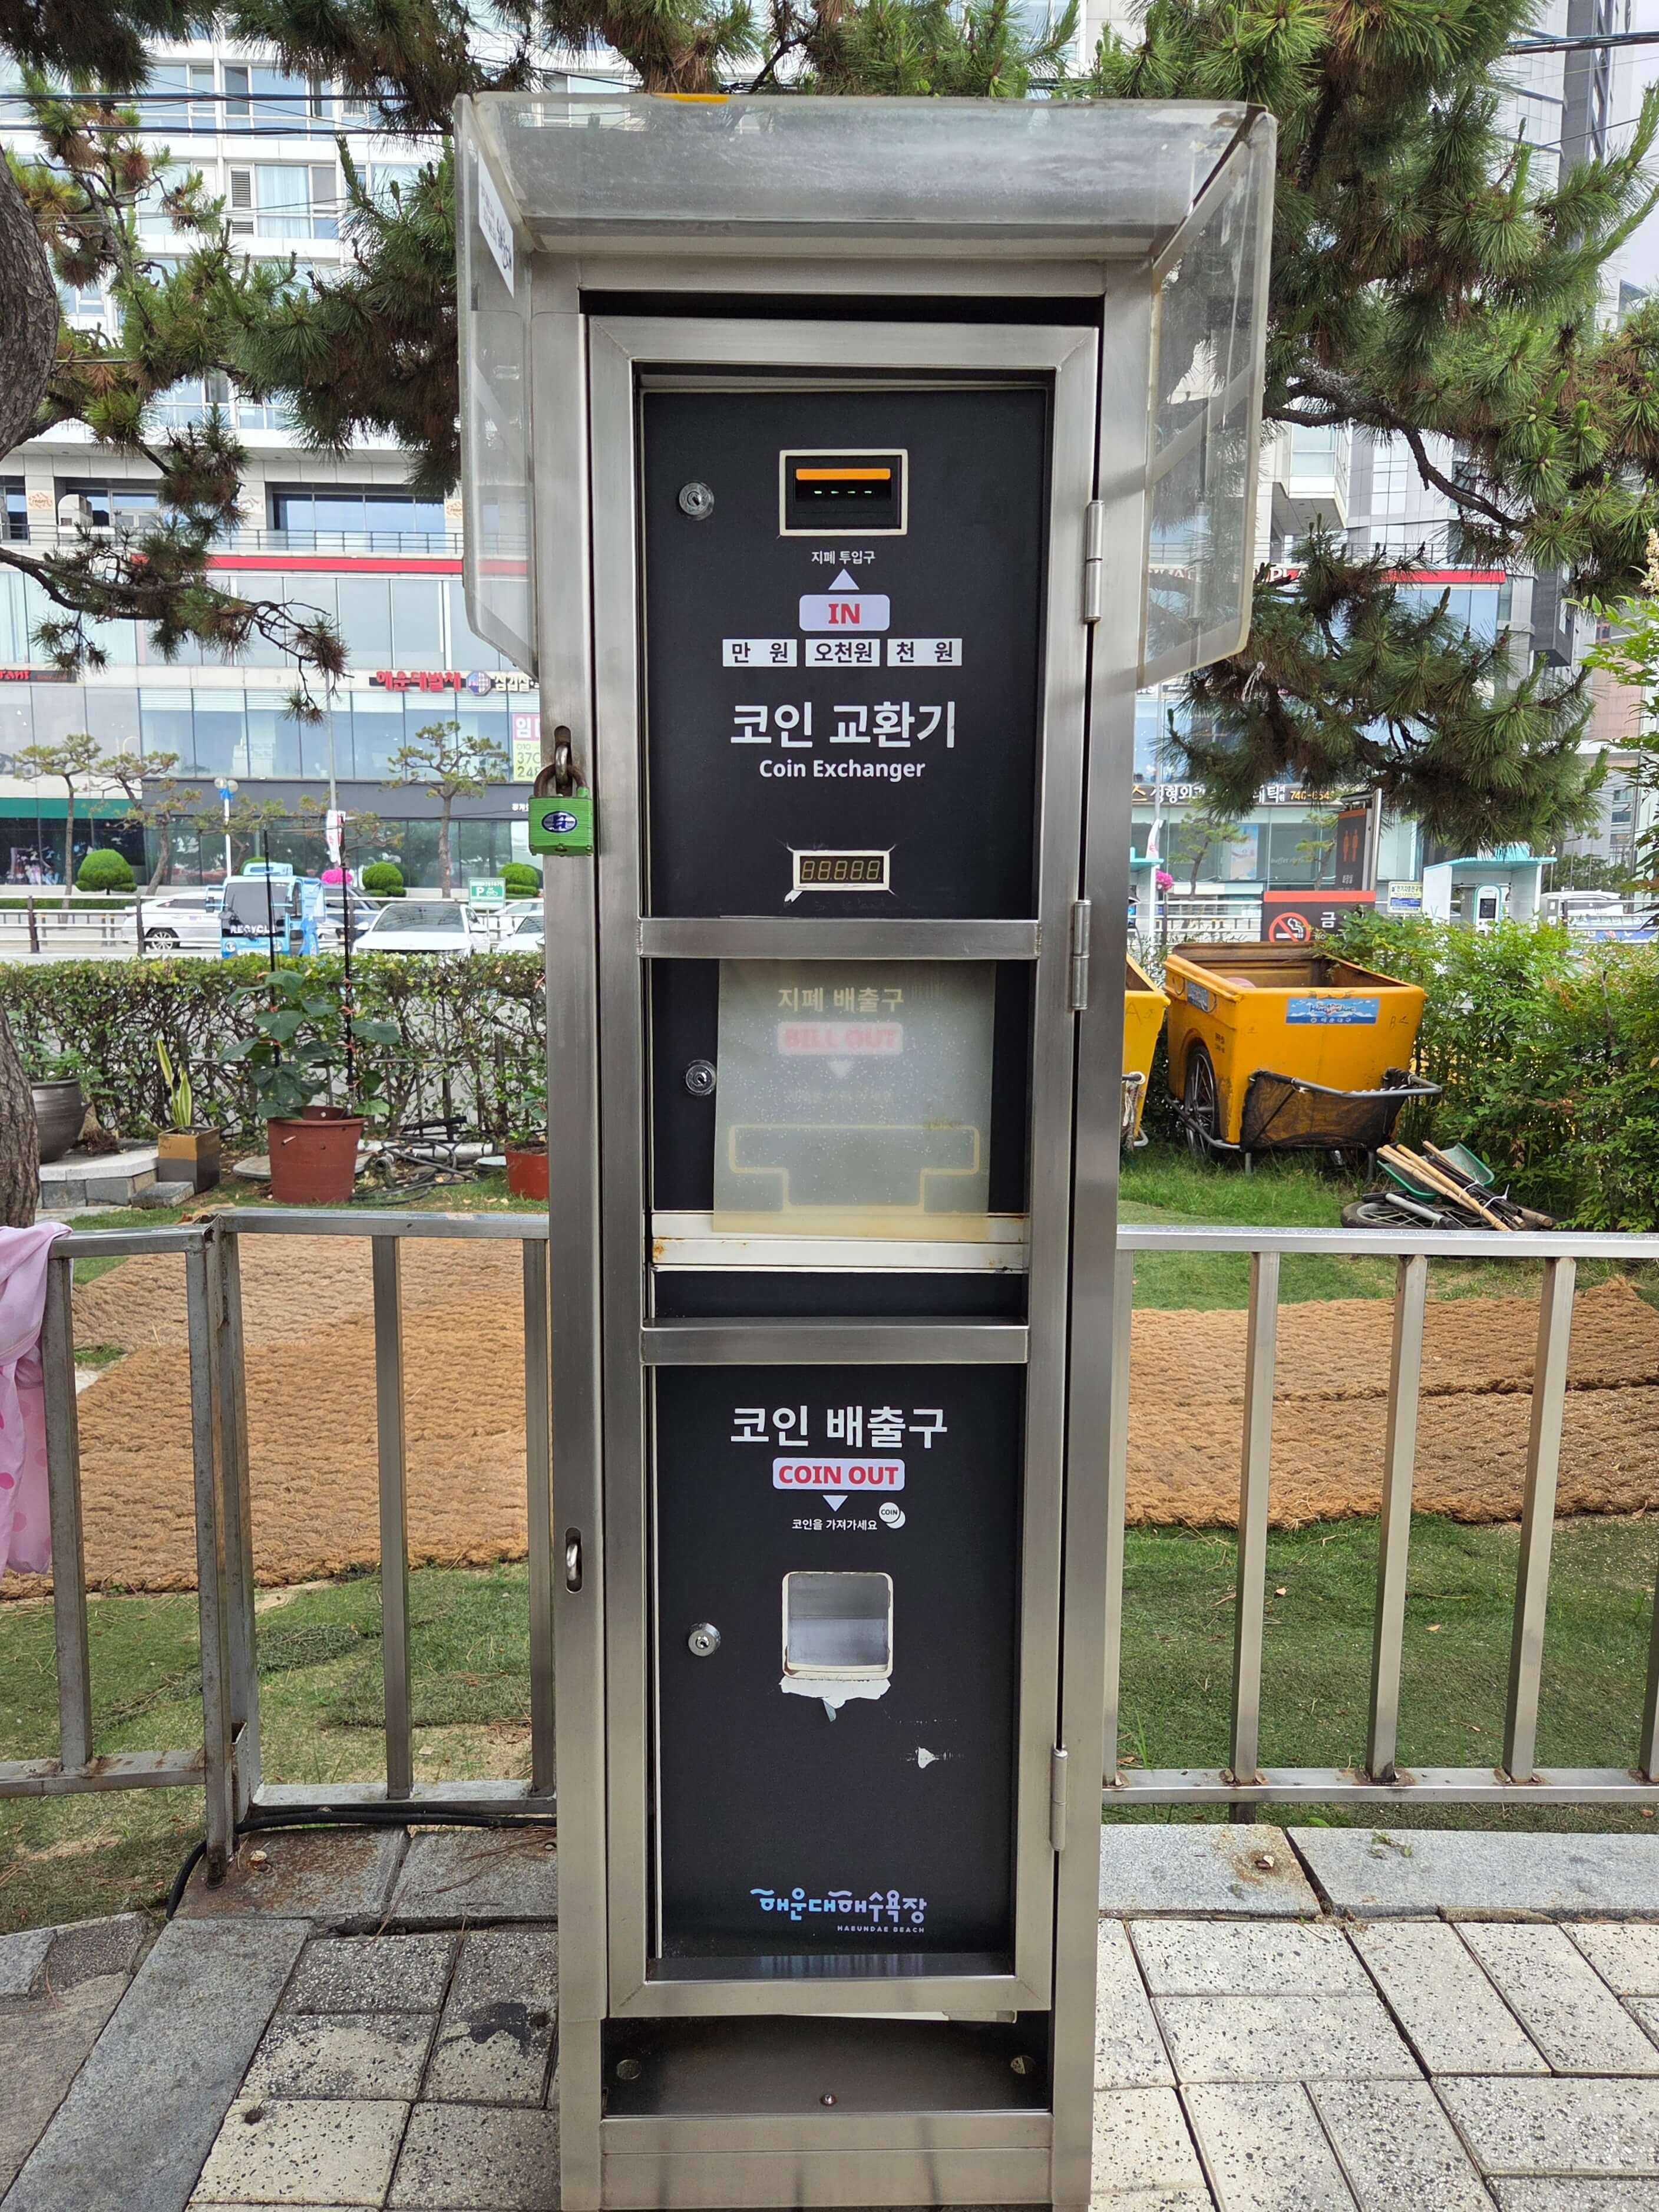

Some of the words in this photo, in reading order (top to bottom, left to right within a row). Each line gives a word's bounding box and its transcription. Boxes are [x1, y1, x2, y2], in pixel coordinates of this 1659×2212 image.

[811, 550, 835, 564] 지폐
[839, 550, 876, 564] 투입구
[828, 603, 860, 624] IN
[732, 642, 751, 663] 만
[769, 642, 788, 663] 원
[814, 641, 873, 663] 오천원
[896, 641, 914, 663] 천
[934, 641, 953, 663] 원
[730, 702, 813, 748] 코인
[830, 701, 956, 748] 교환기
[759, 760, 806, 778] Coin
[813, 759, 926, 783] Exchanger
[778, 987, 824, 1012] 지폐
[833, 987, 904, 1013] 배출구
[730, 1405, 809, 1447] 코인
[827, 1405, 948, 1449] 배출구
[778, 1465, 841, 1484] COIN
[848, 1466, 898, 1485] OUT
[791, 1518, 824, 1531] 코인을
[825, 1519, 878, 1531] 가져가세요
[749, 1887, 927, 1924] 해운대해수욕장
[837, 1924, 889, 1933] HAEUNDAE
